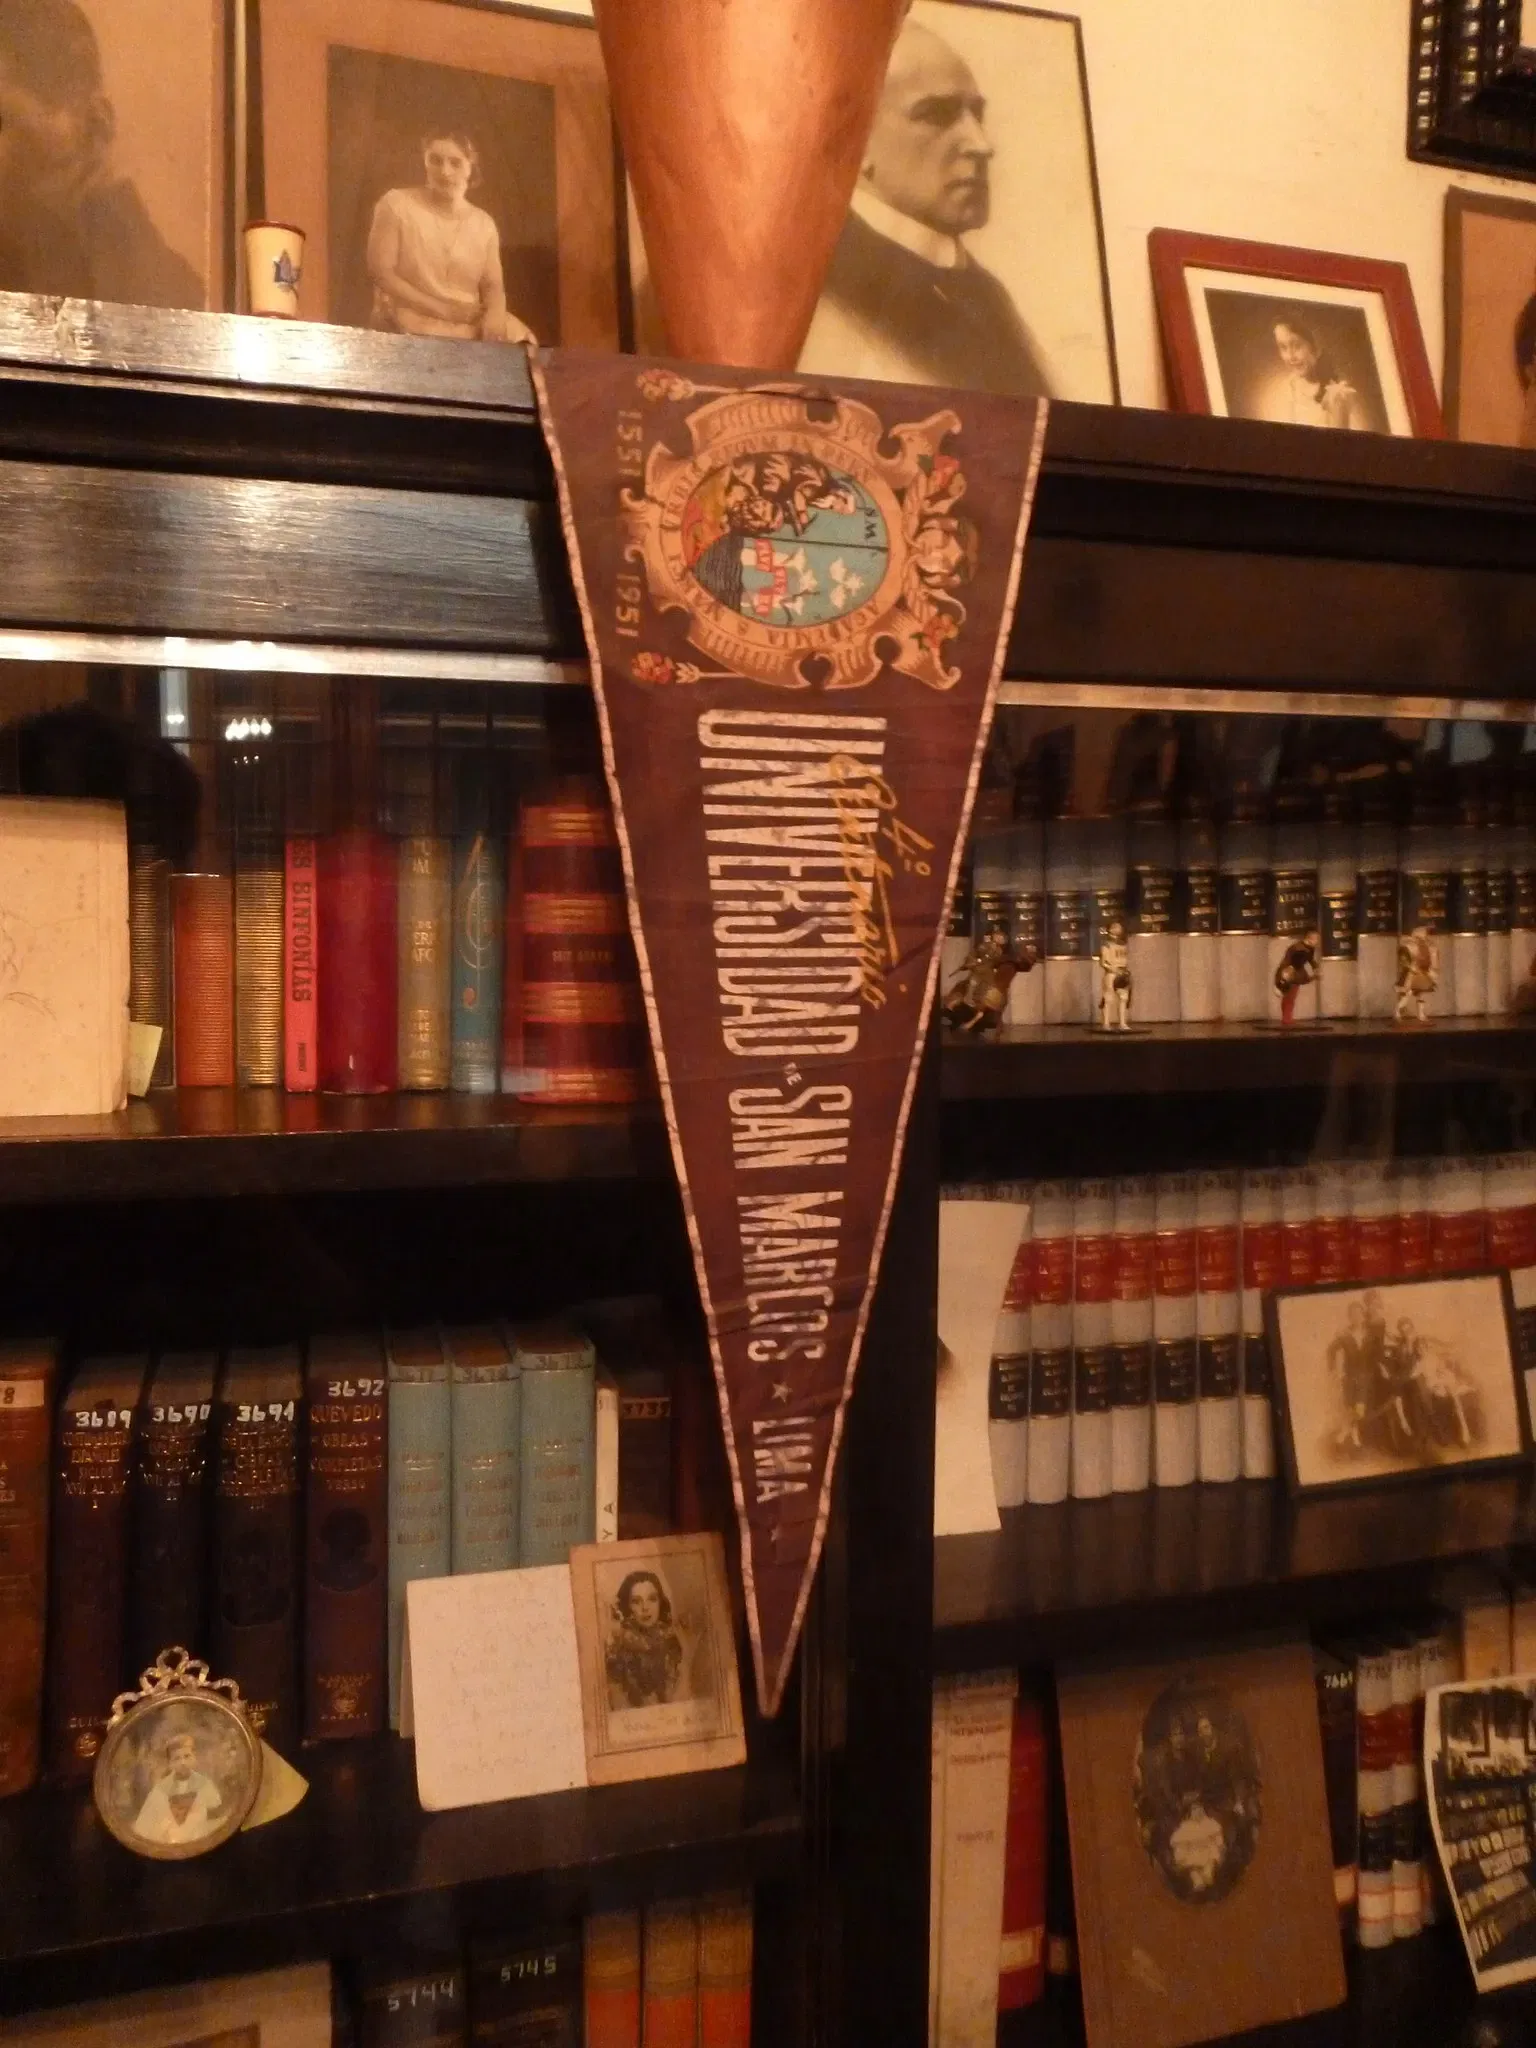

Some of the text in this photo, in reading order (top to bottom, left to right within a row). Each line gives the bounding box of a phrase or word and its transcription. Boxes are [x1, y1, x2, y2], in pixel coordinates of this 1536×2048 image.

[617, 409, 643, 477] 1551
[615, 574, 642, 638] 1951
[697, 709, 888, 1363] UNIVERSIDAD DE SAN MARCOS
[328, 1379, 386, 1398] 3692
[76, 1410, 132, 1429] 3689
[152, 1404, 212, 1425] 3690
[236, 1401, 295, 1422] 3691
[311, 1403, 383, 1424] QUEVEDO
[751, 1416, 817, 1504] LIMA
[500, 1954, 558, 1985] 5745
